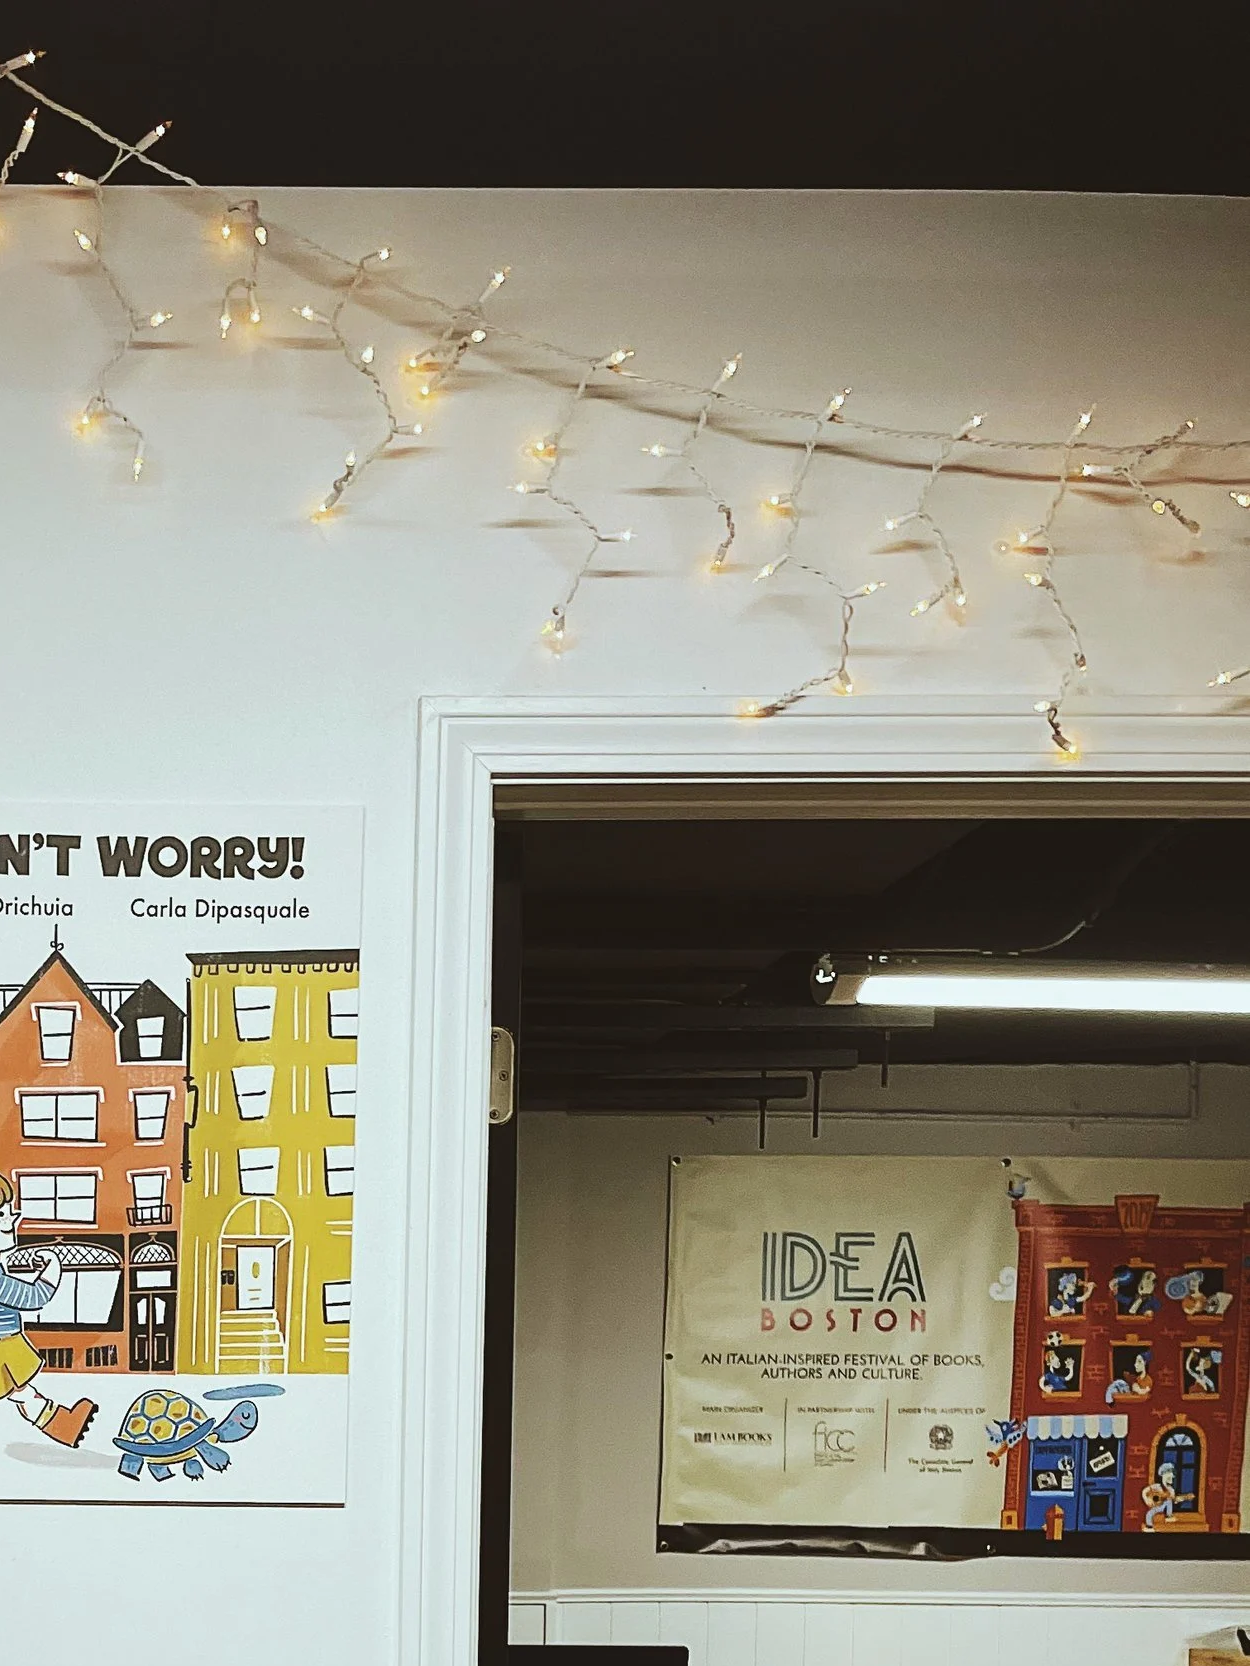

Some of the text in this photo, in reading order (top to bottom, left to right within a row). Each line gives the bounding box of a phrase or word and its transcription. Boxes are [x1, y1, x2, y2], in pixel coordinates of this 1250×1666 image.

[96, 834, 306, 881] WORRY!
[130, 897, 187, 919] Carla
[195, 897, 311, 924] Dipasquale
[761, 1231, 927, 1302] IDEA
[760, 1307, 927, 1333] BOSTON
[701, 1353, 722, 1366] AN
[844, 1354, 904, 1366] FESTIVAL
[910, 1355, 929, 1366] OF
[933, 1354, 985, 1368] BOOKS,
[761, 1367, 823, 1380] AUTHORS
[828, 1367, 857, 1380] AND
[737, 1431, 773, 1443] BOOKS
